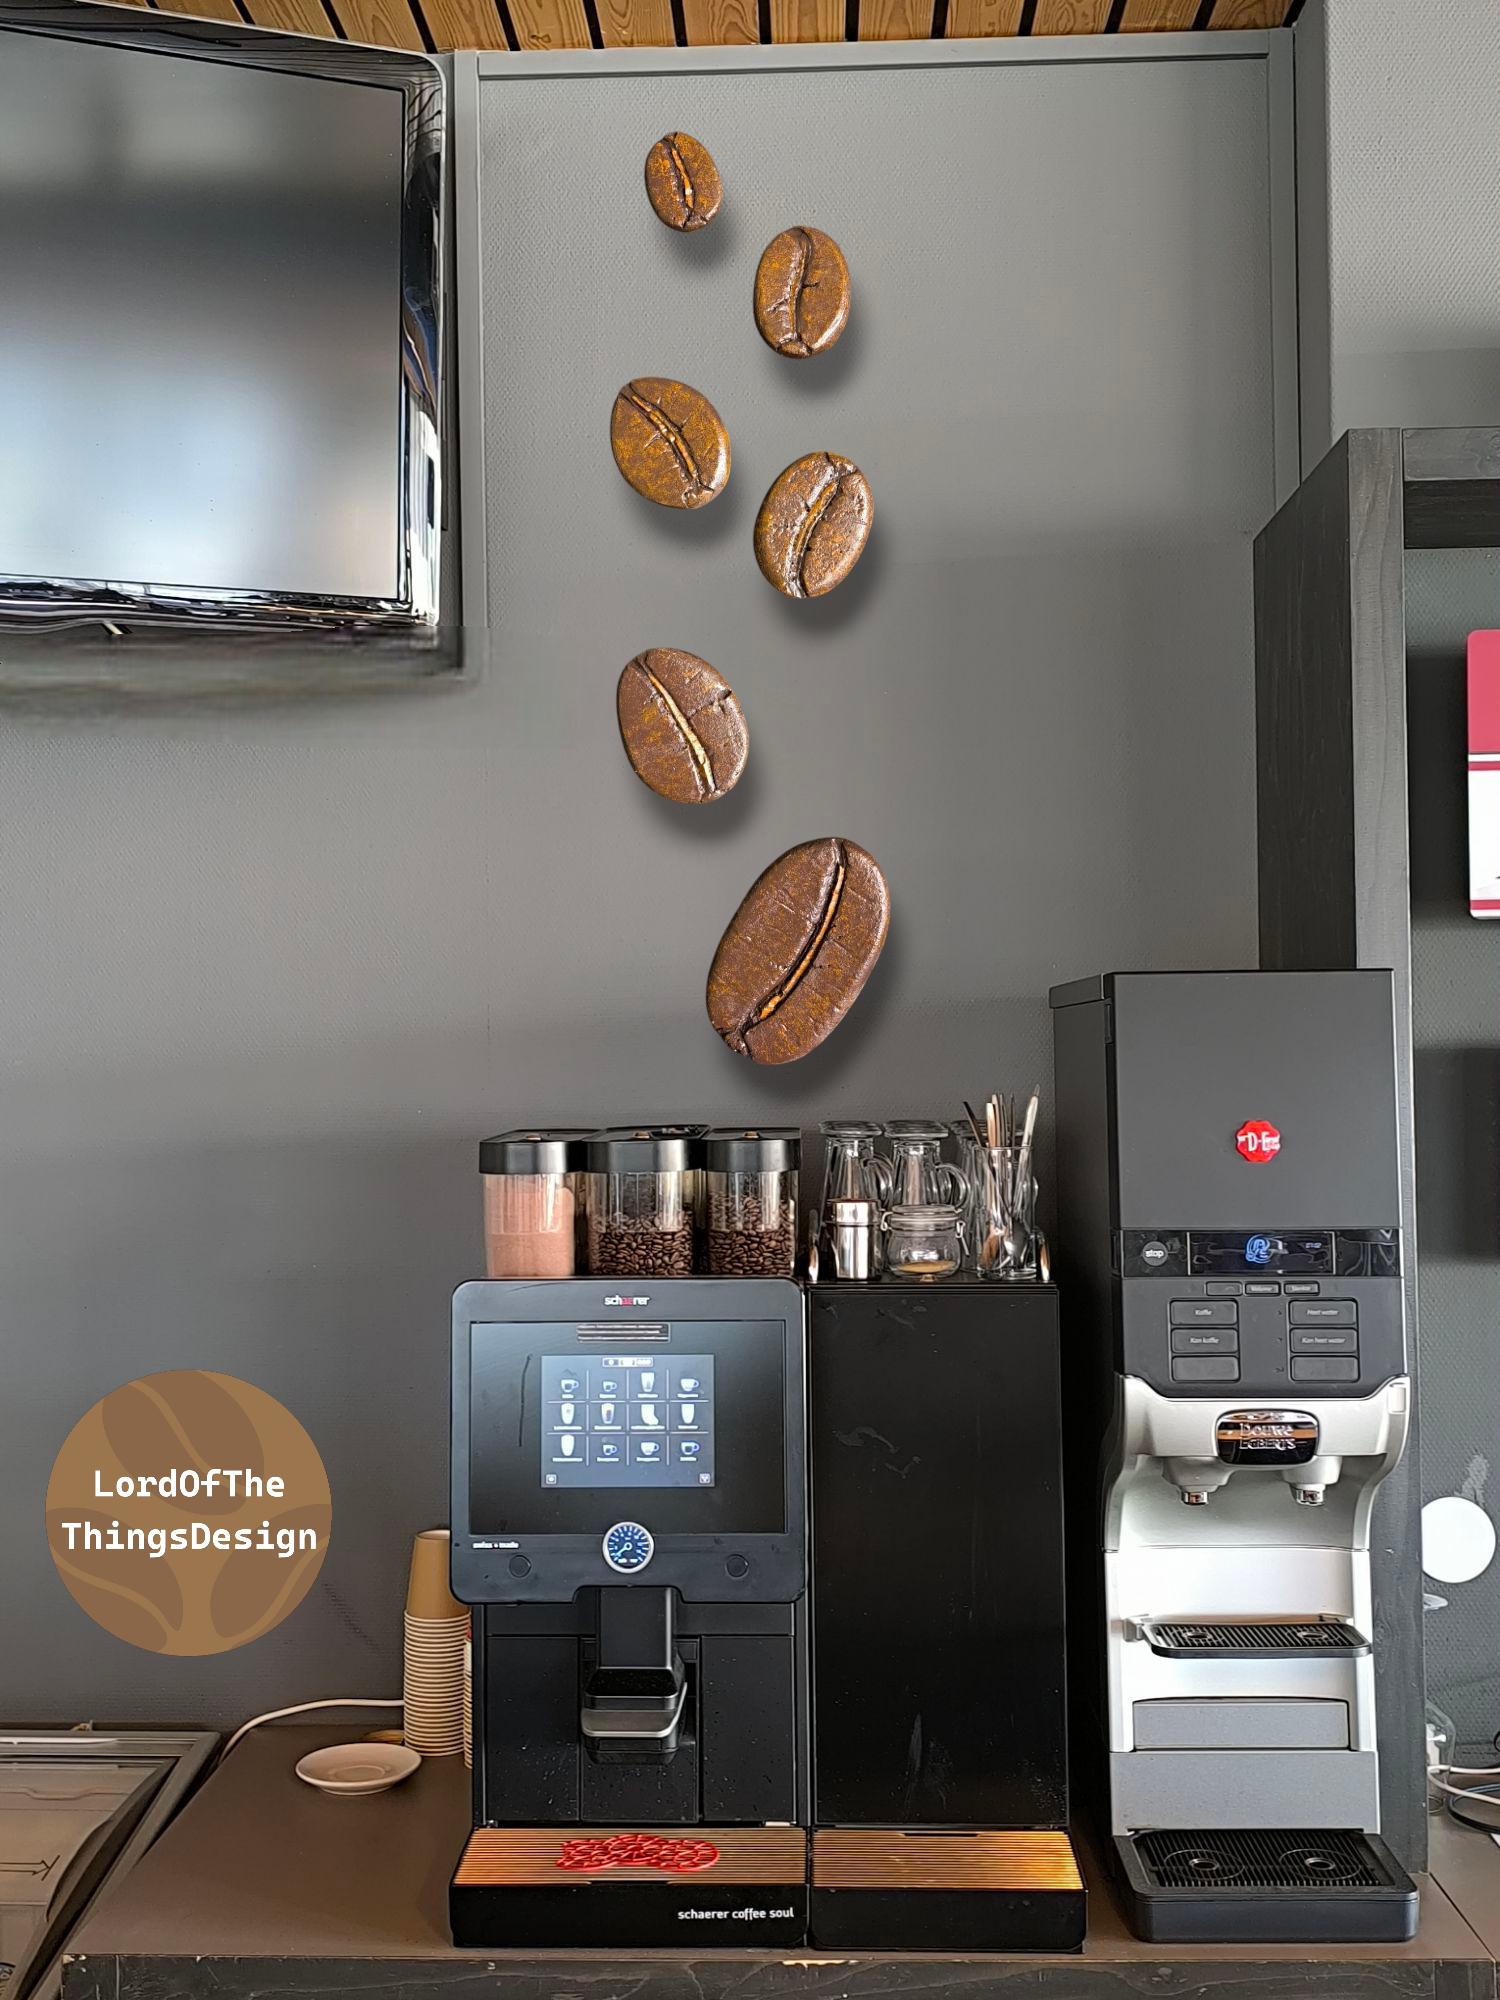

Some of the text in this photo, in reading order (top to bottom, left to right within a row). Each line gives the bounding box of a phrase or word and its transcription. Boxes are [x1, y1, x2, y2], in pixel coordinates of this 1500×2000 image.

[1145, 1249, 1164, 1259] stop
[677, 1906, 794, 1921] schaerer coffee soul
